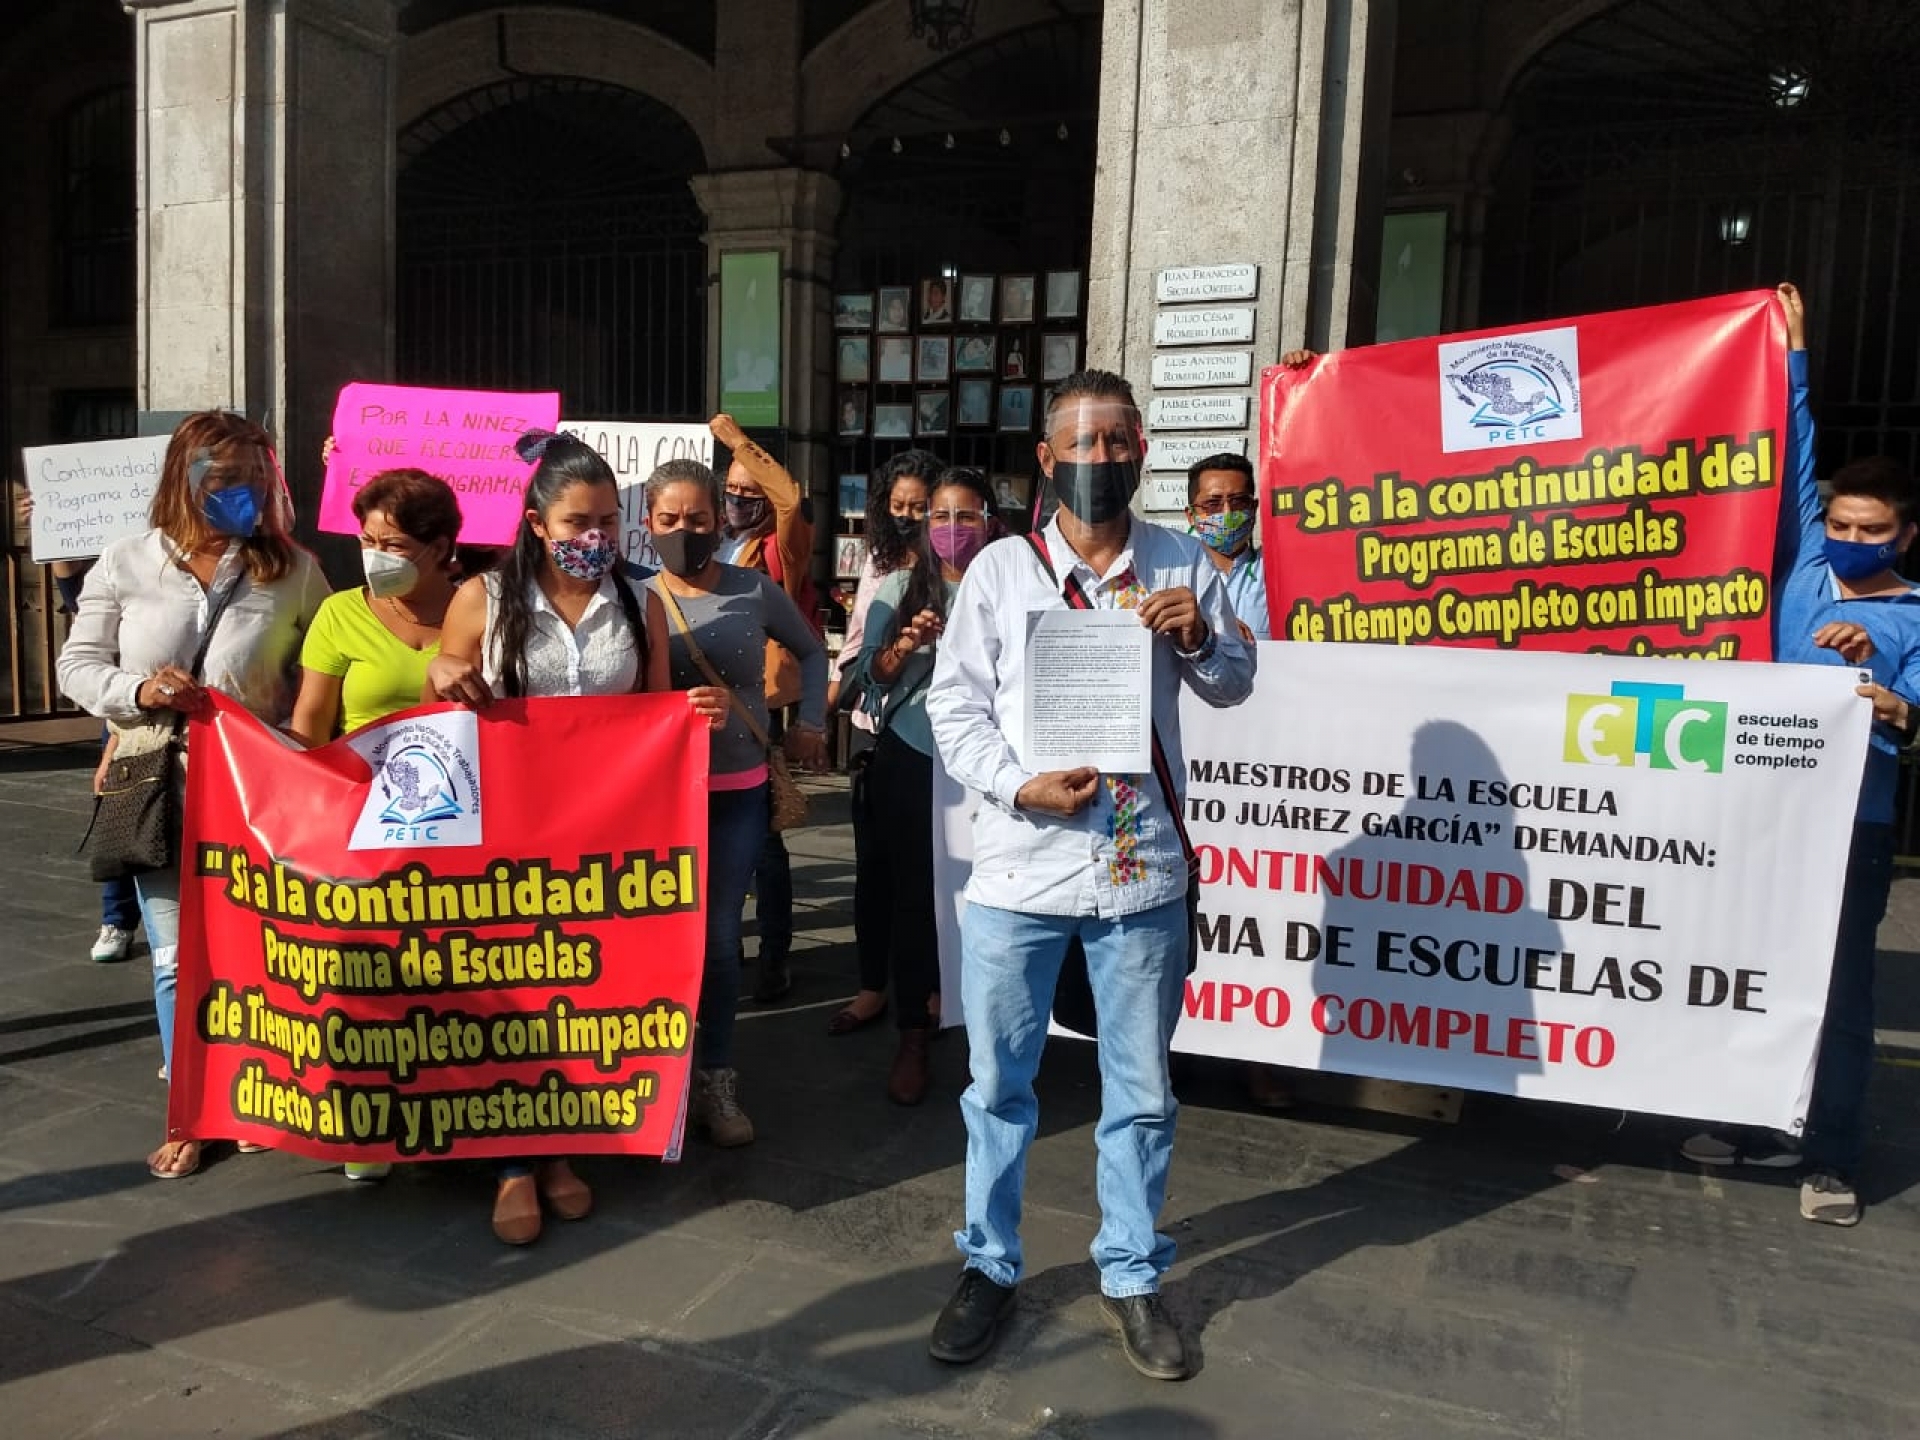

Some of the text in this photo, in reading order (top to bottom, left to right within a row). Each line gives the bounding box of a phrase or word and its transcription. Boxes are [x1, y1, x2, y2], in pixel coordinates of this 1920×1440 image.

[360, 405, 407, 426] POR
[423, 411, 450, 426] LA
[367, 437, 409, 455] QUE
[1488, 425, 1546, 442] PETC
[41, 450, 158, 482] Continuidad
[41, 482, 151, 511] Programa de
[1349, 492, 1371, 523] a
[1380, 478, 1418, 520] la
[1428, 446, 1689, 516] continuidad
[1701, 437, 1771, 489] del
[43, 510, 114, 534] Completo
[1362, 508, 1678, 584] Programa de Escuelas
[1292, 573, 1764, 646] de Tiempo Completo con impacto
[1736, 731, 1825, 751] de tiempo
[1738, 713, 1819, 730] escuelas
[1190, 759, 1618, 816] MAESTROS DE LA ESCUELA
[1734, 751, 1818, 771] completo
[384, 826, 439, 842] PETC
[1235, 799, 1350, 833] JUÁREZ
[1514, 824, 1716, 868] DEMANDAN:
[254, 872, 269, 910] a
[273, 863, 307, 916] la
[314, 863, 605, 923] continuidad
[618, 853, 694, 910] del
[1194, 844, 1661, 930] ONTINUIDAD DEL
[264, 926, 592, 997] Programa de Escuelas
[1195, 912, 1767, 1014] MA DE ESCUELAS DE
[206, 986, 688, 1077] de Tiempo Completo con impacto
[1184, 979, 1616, 1069] MPO COMPLETO
[237, 1064, 313, 1133] directo
[318, 1087, 344, 1138] al
[351, 1091, 391, 1138] 07
[401, 1099, 421, 1148] y
